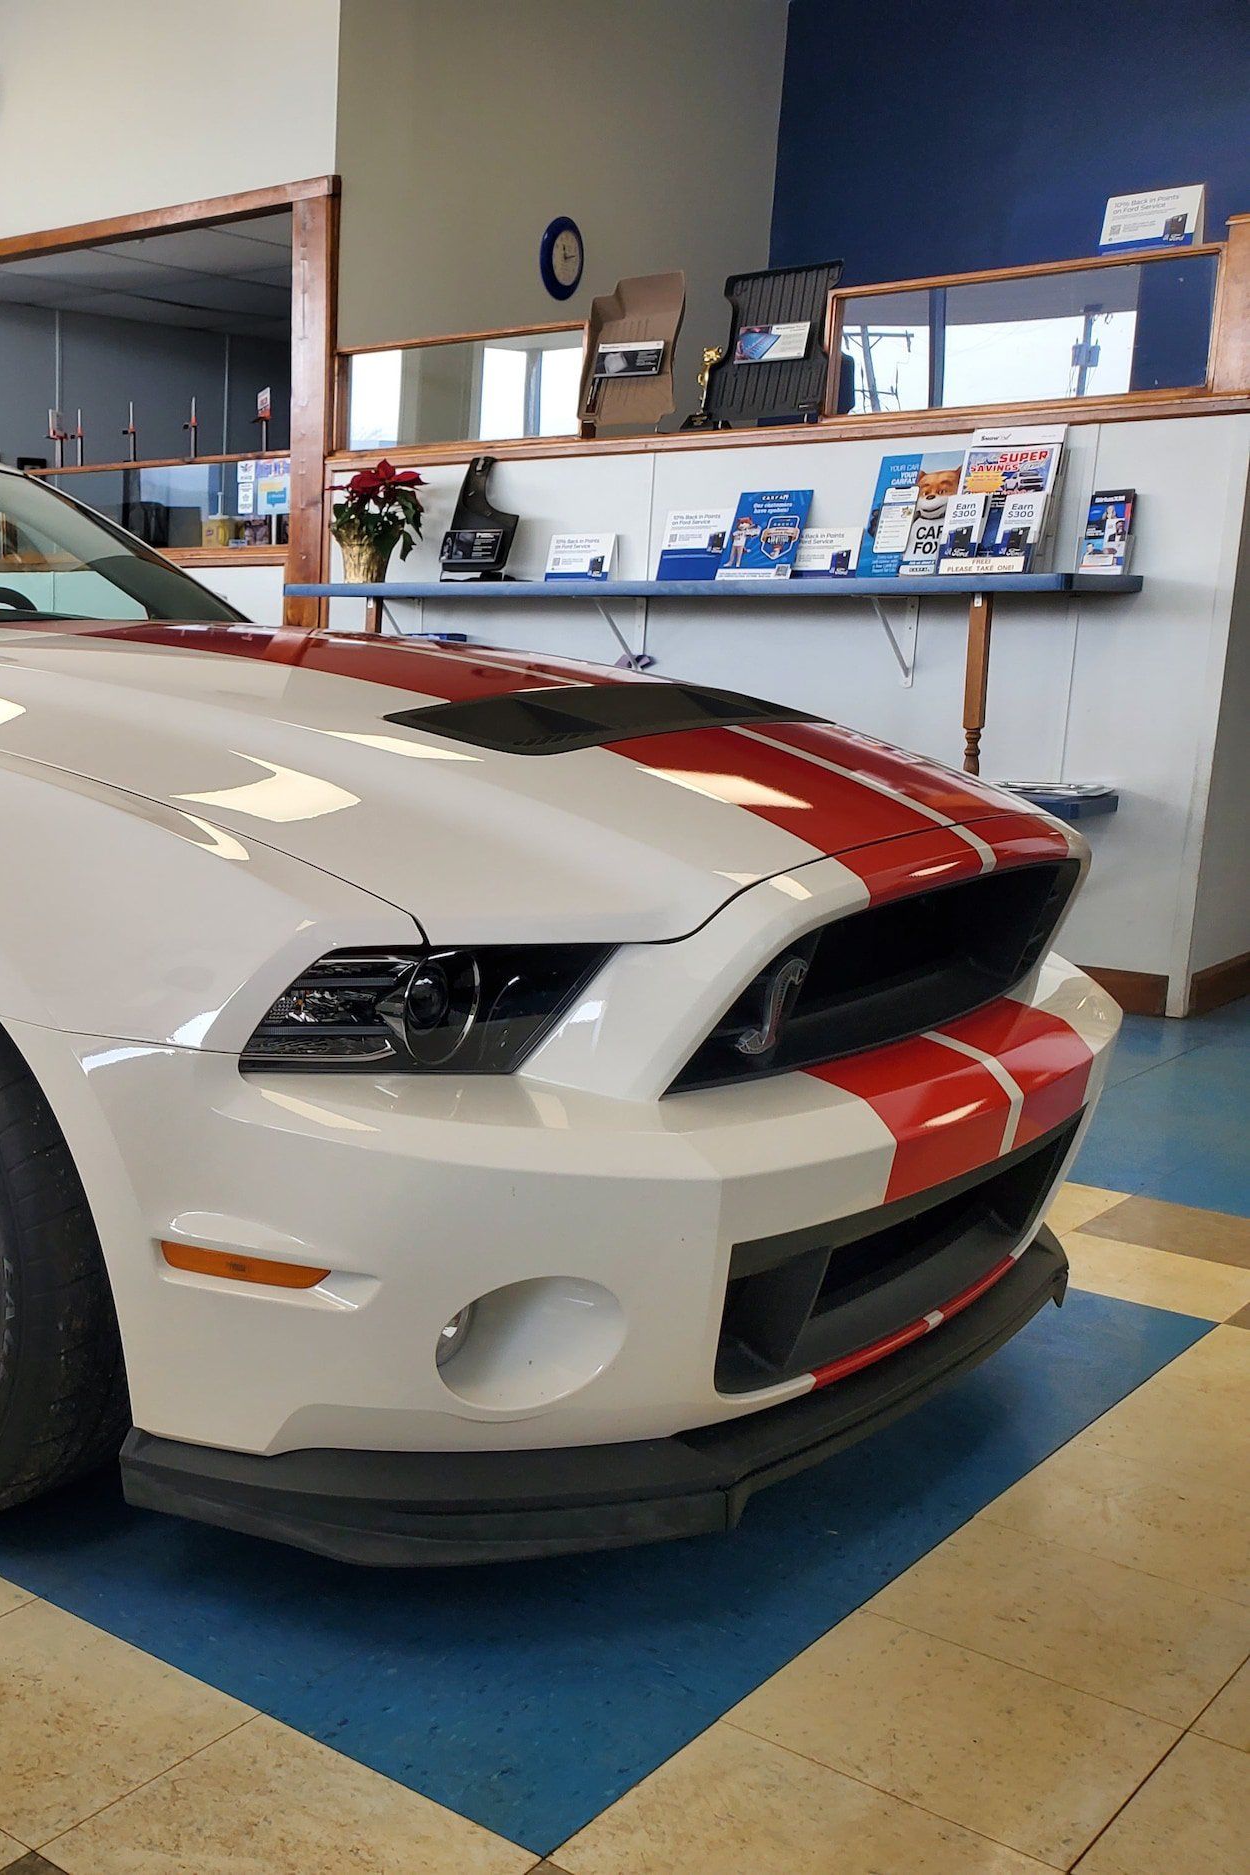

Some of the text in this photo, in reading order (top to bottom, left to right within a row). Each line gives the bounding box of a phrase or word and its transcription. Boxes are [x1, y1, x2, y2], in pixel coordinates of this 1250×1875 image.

[1123, 206, 1139, 214] Ford
[999, 450, 1049, 463] SUPER
[970, 463, 1019, 472] SAVINGS
[956, 503, 976, 511] Earn
[1011, 503, 1034, 511] Earn
[952, 510, 977, 519] $300
[1007, 510, 1034, 519] $300
[952, 547, 969, 557] Ford
[1006, 547, 1025, 557] Ford
[947, 565, 973, 573] PLEASE
